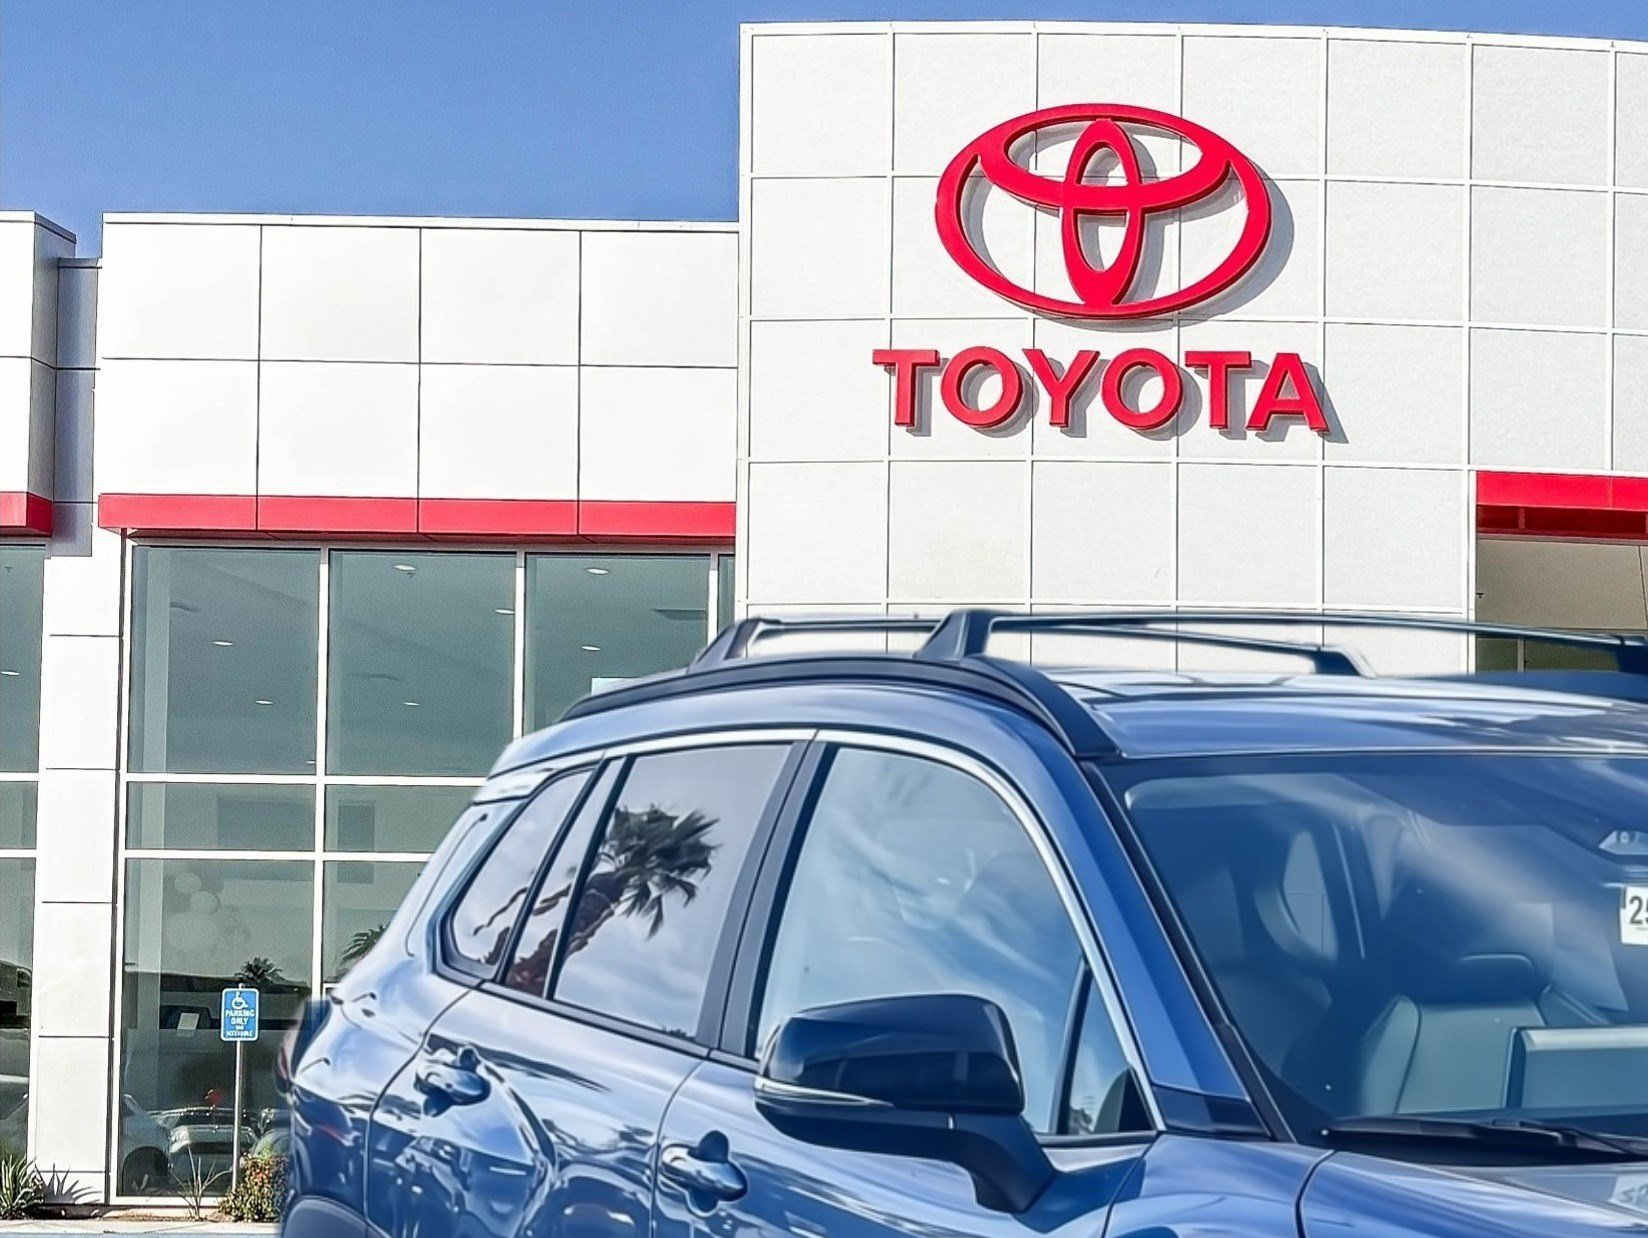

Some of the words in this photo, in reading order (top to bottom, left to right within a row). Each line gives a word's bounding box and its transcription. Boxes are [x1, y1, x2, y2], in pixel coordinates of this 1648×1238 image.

[872, 346, 1331, 434] TOYOTA
[225, 1009, 255, 1018] PARKING
[230, 1016, 249, 1025] ONLY
